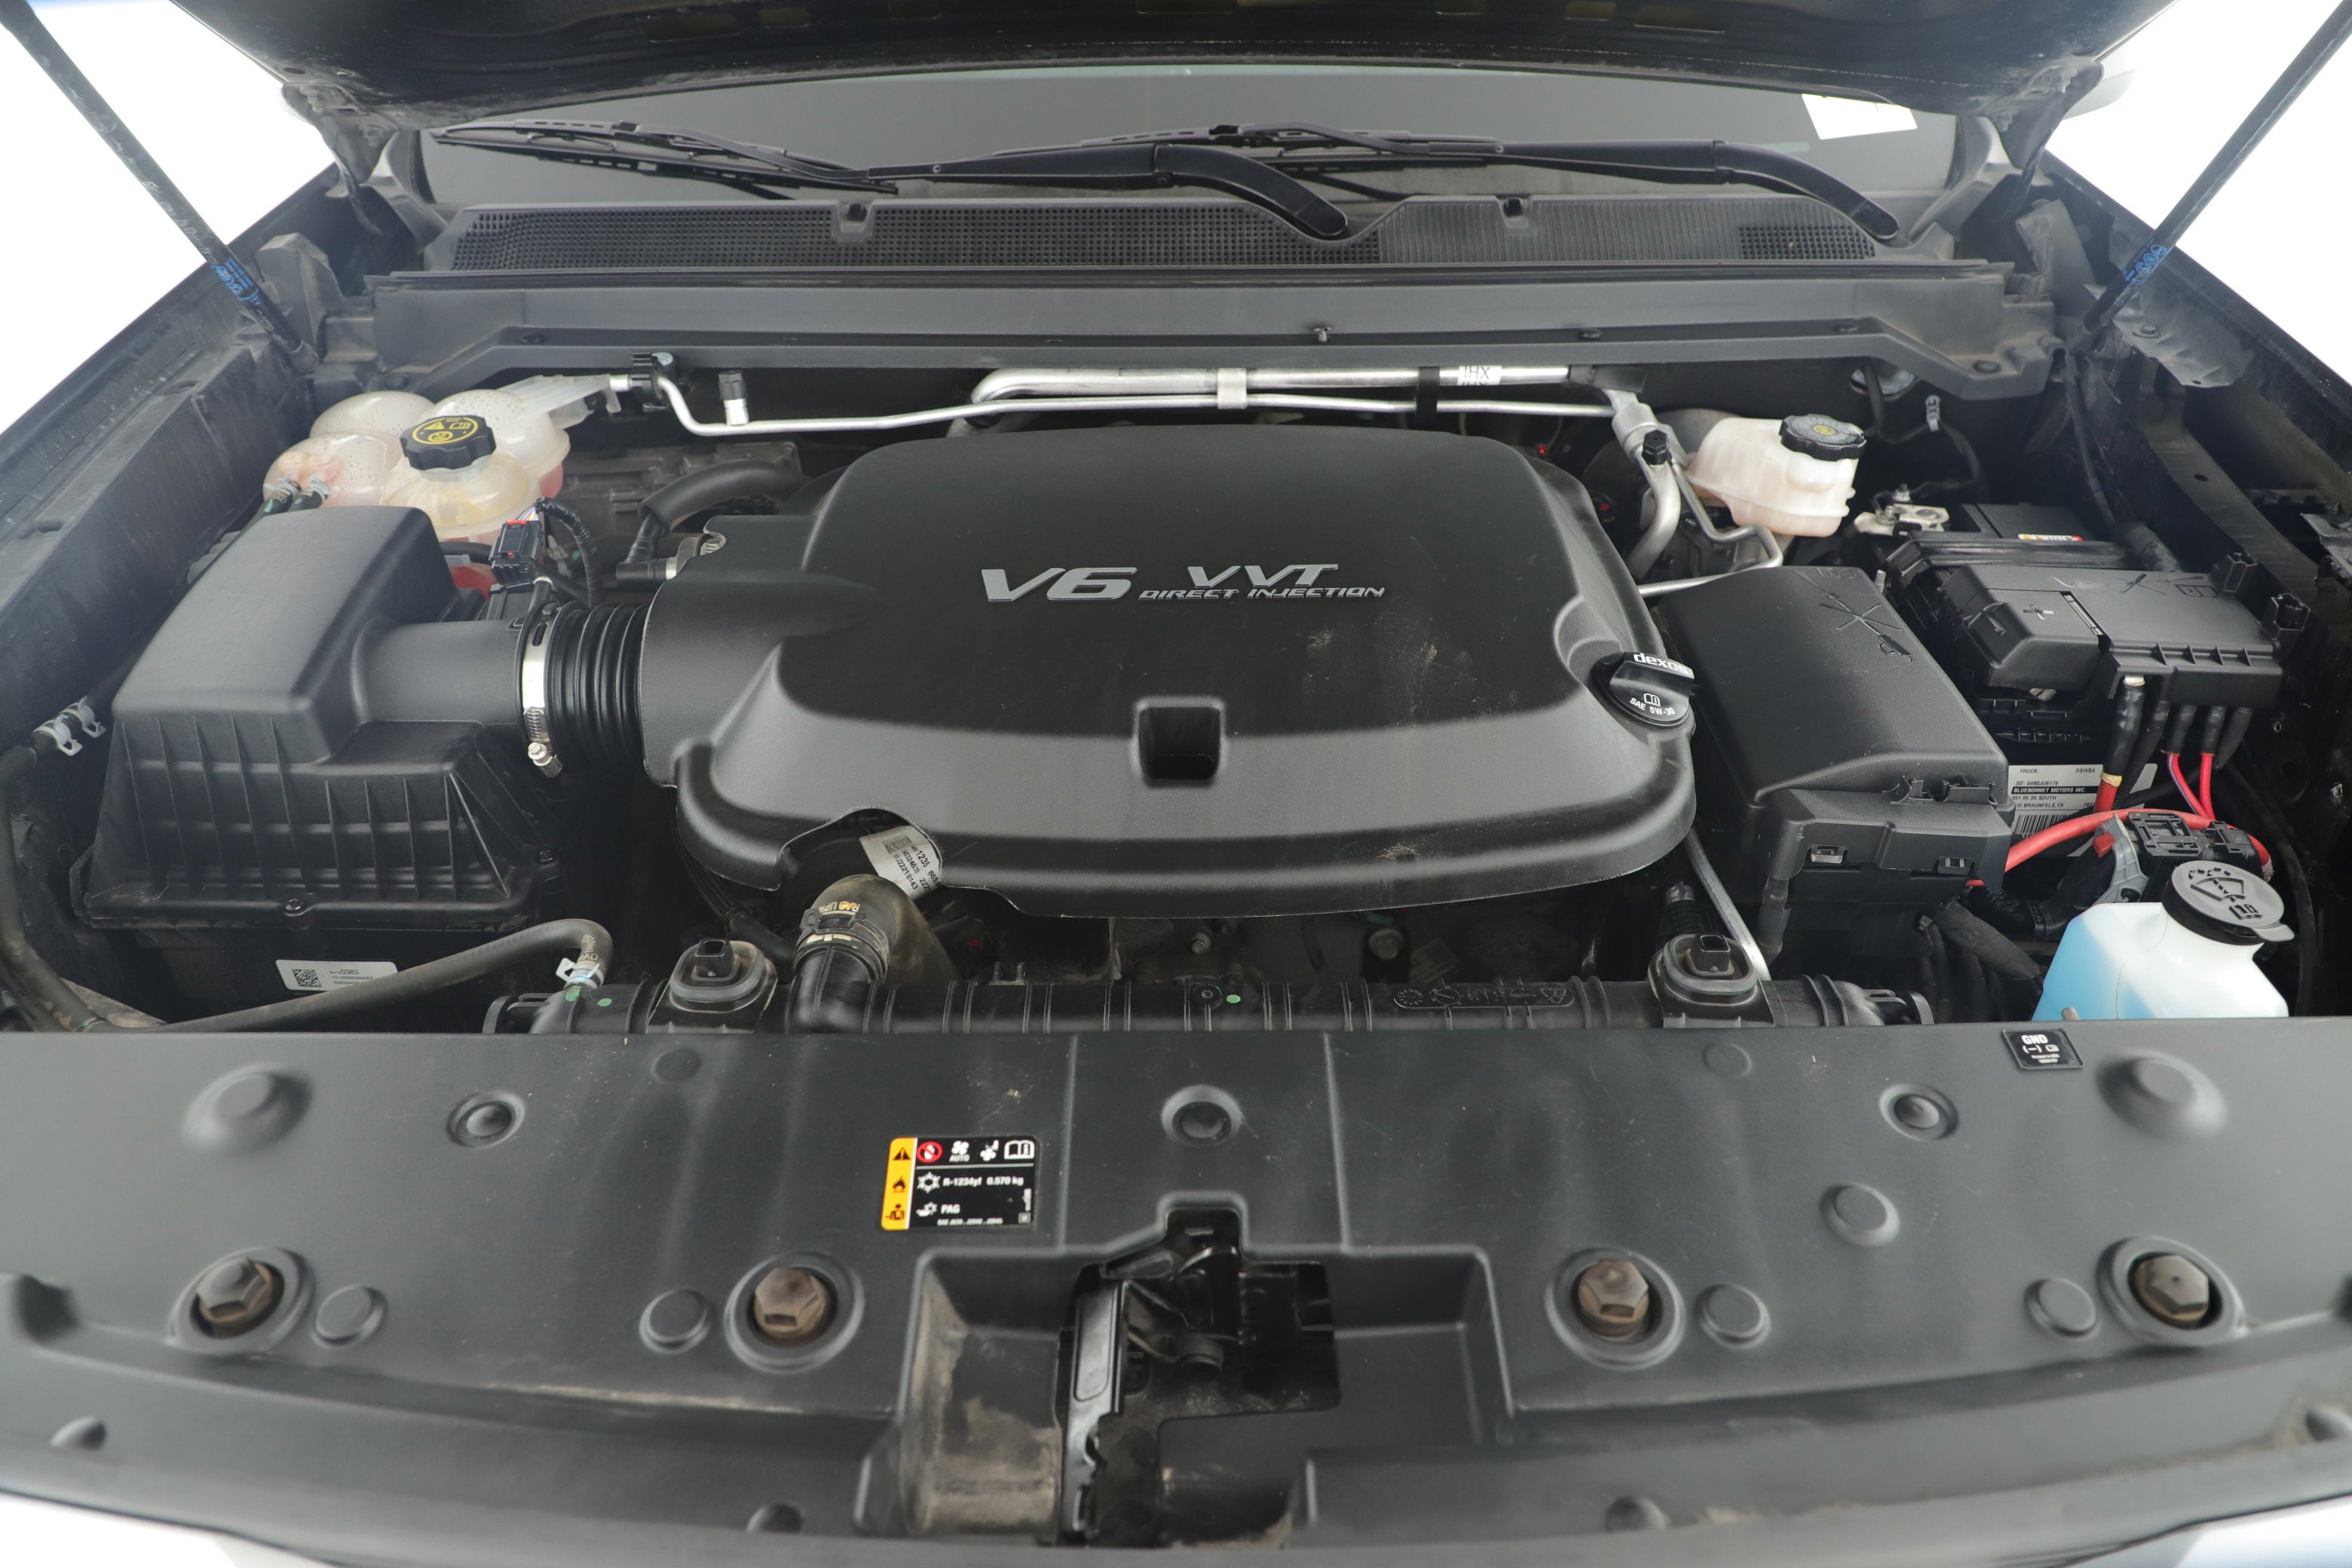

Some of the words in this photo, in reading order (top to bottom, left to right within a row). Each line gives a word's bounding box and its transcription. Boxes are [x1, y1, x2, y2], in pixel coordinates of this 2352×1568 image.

[1187, 563, 1339, 588] VVT
[982, 566, 1138, 602] V6
[1138, 586, 1241, 601] DIRECT
[1247, 585, 1386, 599] INJECTION
[1633, 653, 1689, 675] dexos
[1629, 697, 1646, 711] SAE
[1649, 706, 1676, 716] 5W-30
[2020, 1034, 2048, 1045] GND
[949, 1154, 970, 1162] AUTO
[942, 1176, 983, 1187] R-1234yf
[986, 1176, 1011, 1186] 0.570
[1012, 1176, 1024, 1187] kg
[941, 1204, 960, 1214] PAG
